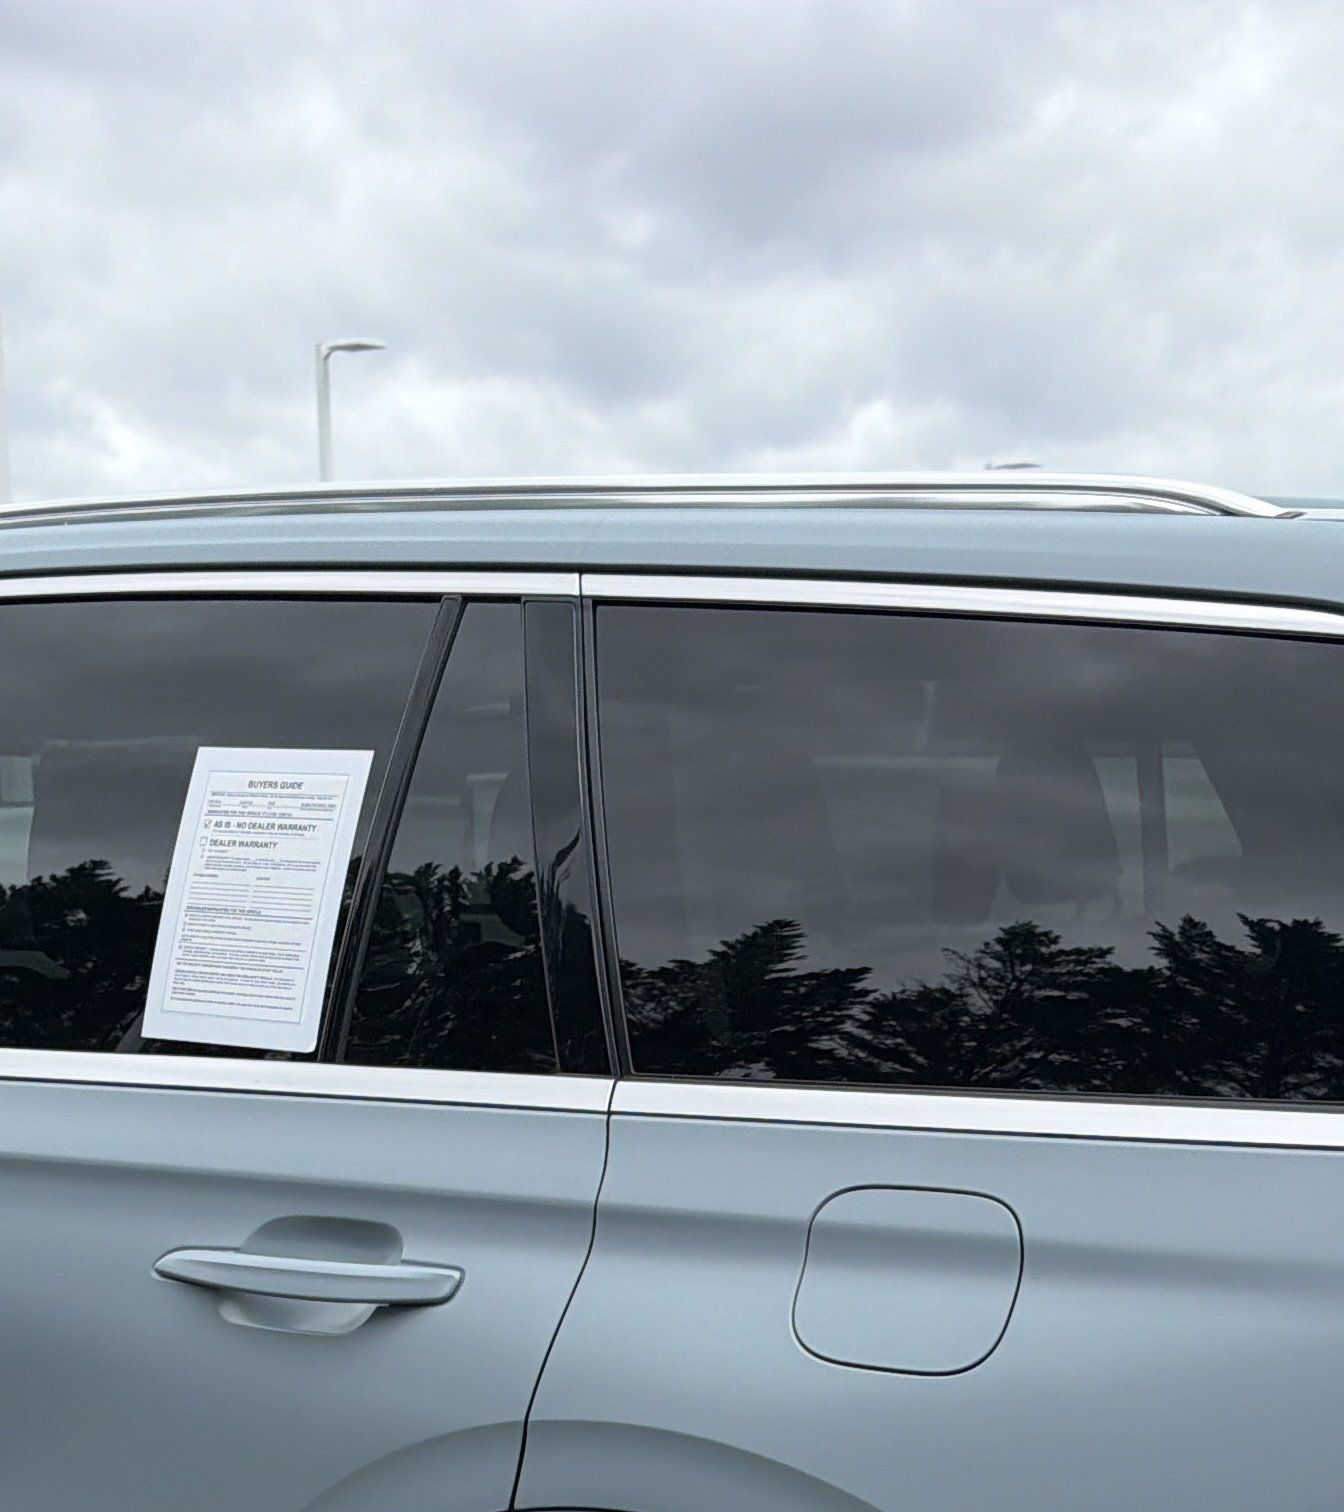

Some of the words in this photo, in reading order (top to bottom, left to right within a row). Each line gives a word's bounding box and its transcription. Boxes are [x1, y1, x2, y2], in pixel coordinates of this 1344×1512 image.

[248, 780, 278, 790] BUYERS
[279, 780, 304, 790] GUIDE
[213, 820, 223, 828] AS
[236, 821, 247, 829] NO
[248, 821, 276, 831] DEALER
[277, 823, 317, 832] WARRANTY
[209, 838, 237, 847] DEALER
[238, 839, 278, 849] WARRANTY
